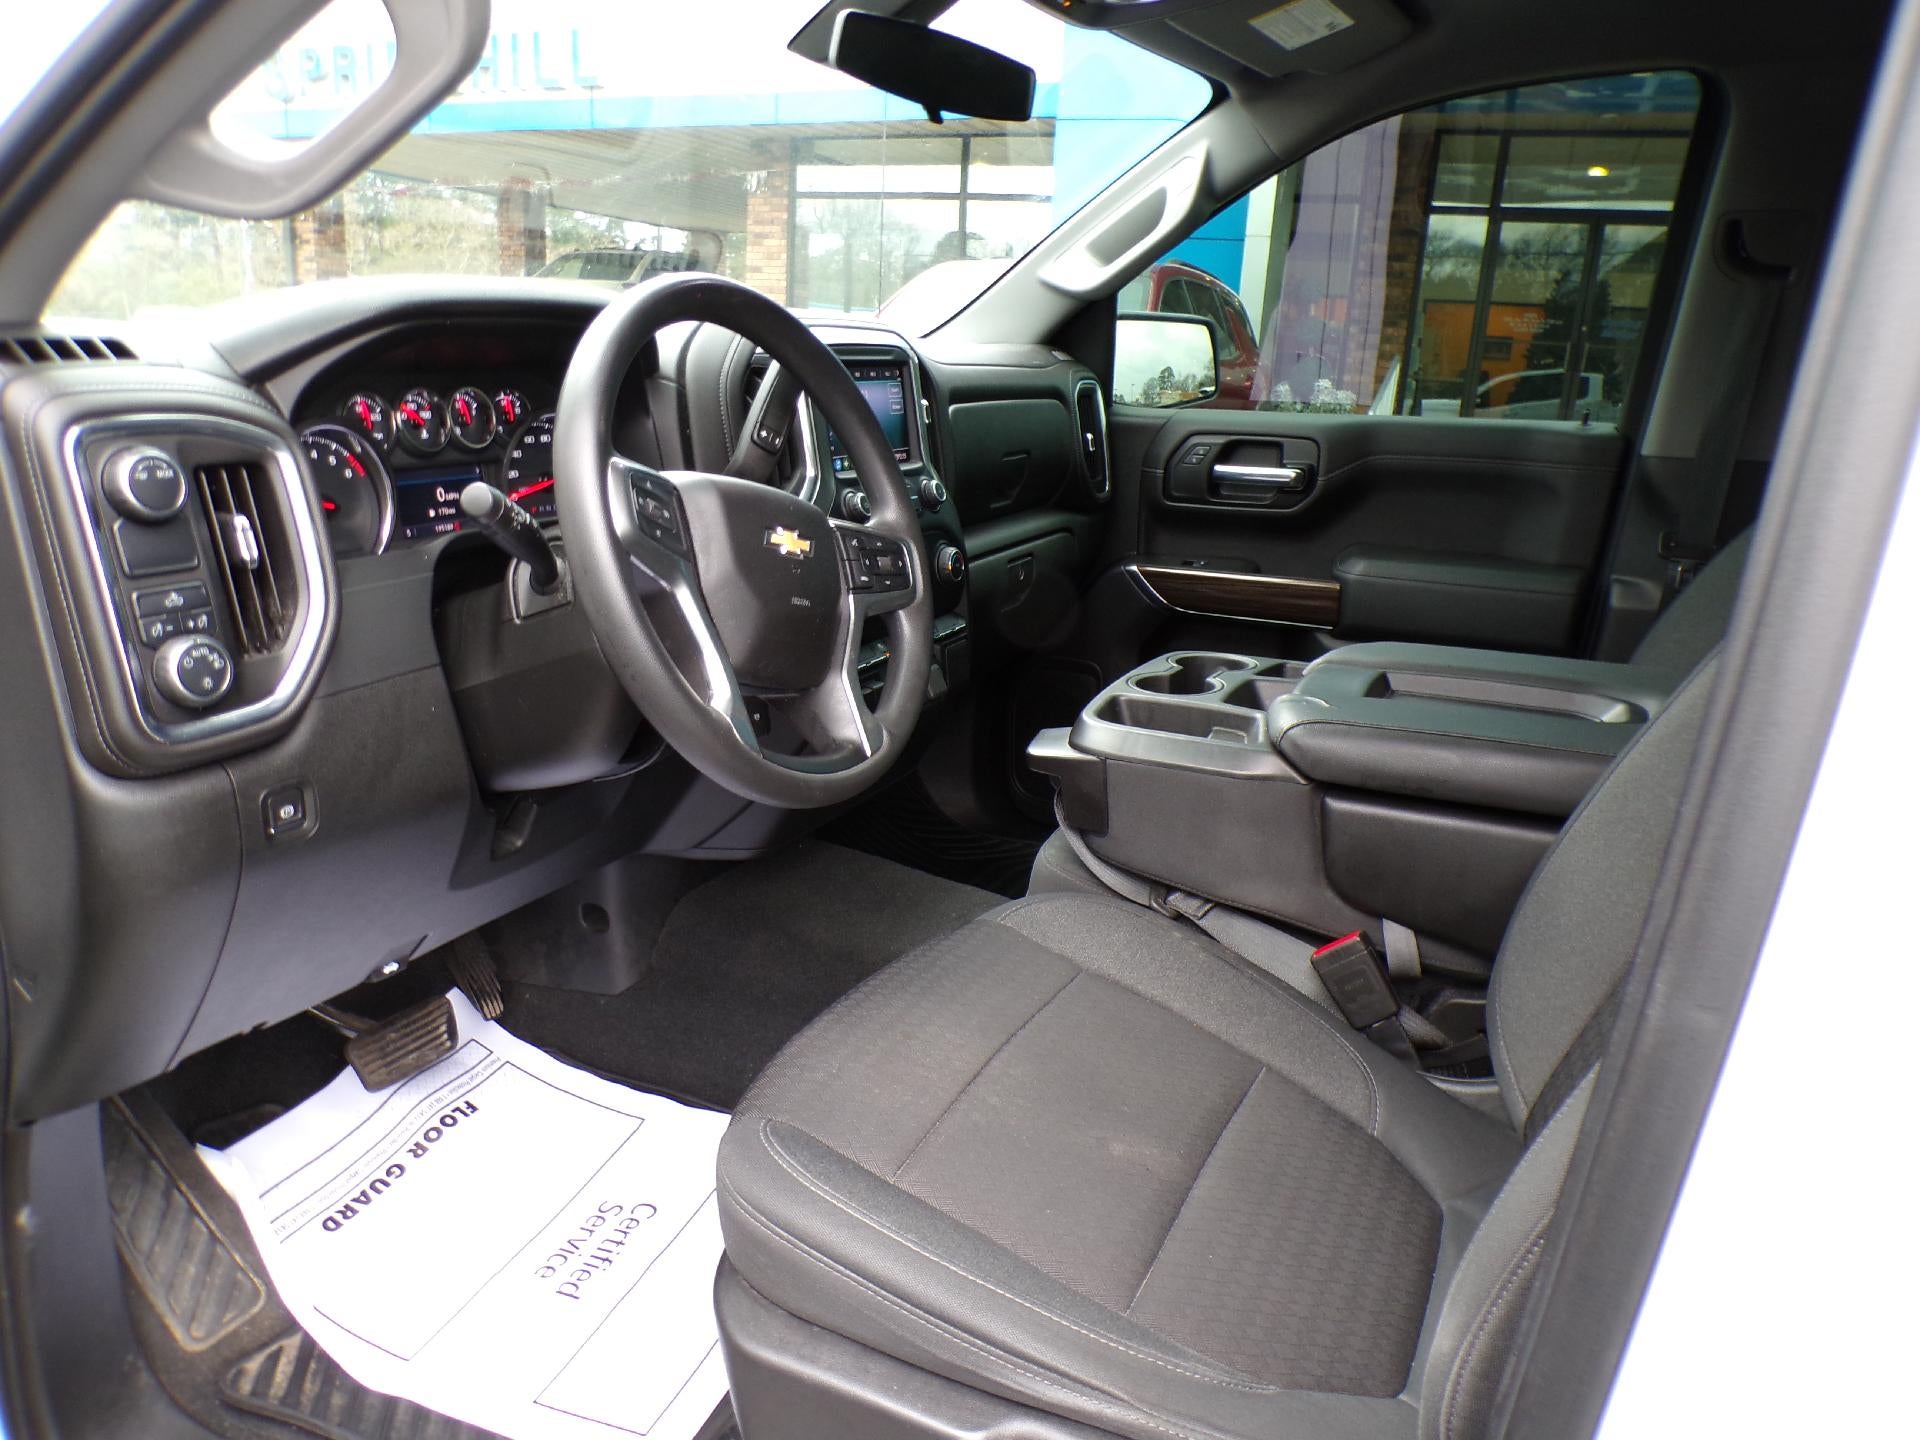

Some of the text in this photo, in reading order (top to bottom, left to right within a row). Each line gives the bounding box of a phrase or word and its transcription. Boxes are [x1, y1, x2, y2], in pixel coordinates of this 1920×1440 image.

[472, 28, 600, 89] HILL
[406, 1100, 479, 1159] FLOOR
[322, 1163, 406, 1232] GUARD
[534, 1200, 623, 1279] Service
[556, 1203, 657, 1300] Certified
